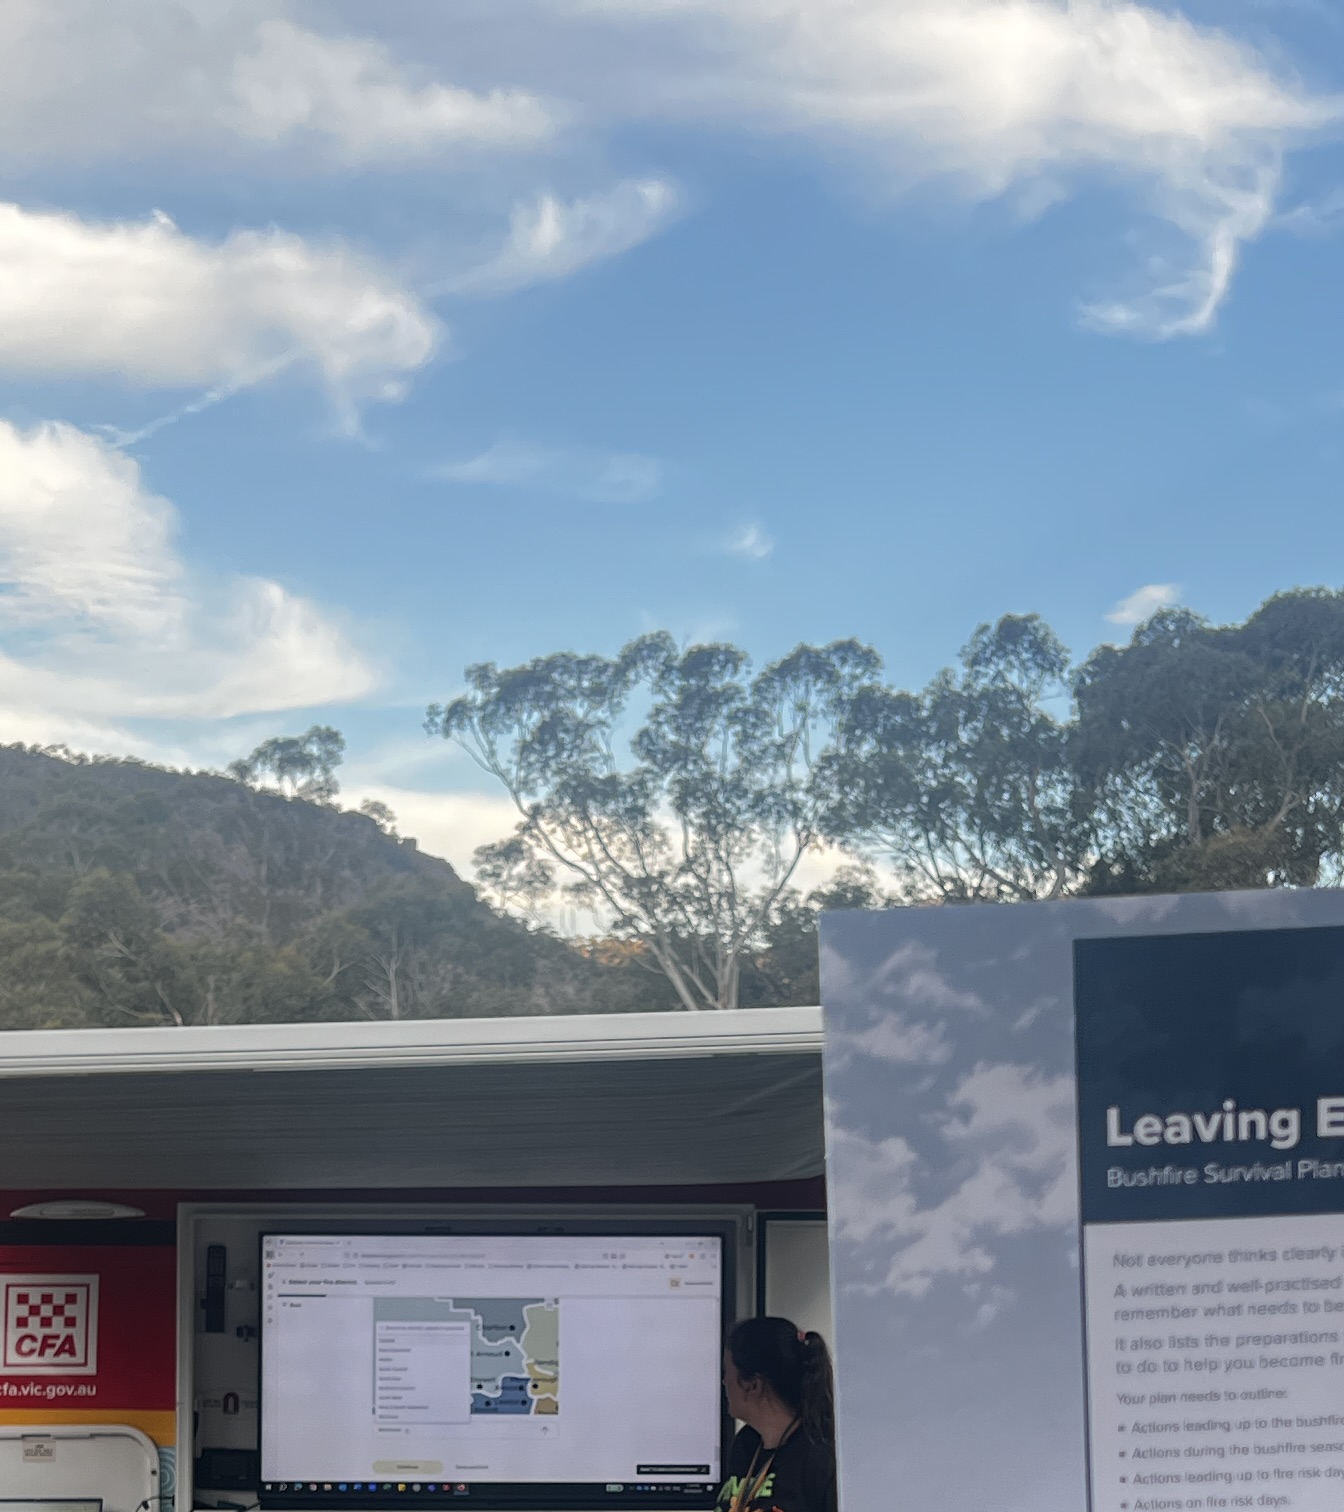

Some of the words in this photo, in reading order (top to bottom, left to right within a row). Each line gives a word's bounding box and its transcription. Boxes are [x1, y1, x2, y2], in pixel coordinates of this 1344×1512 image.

[1106, 1098, 1301, 1149] Leaving
[1106, 1164, 1198, 1188] Bushfire
[1203, 1160, 1292, 1184] Survival
[1112, 1252, 1142, 1268] Not
[1147, 1251, 1223, 1269] everyone
[1227, 1247, 1276, 1262] thinks
[1281, 1245, 1336, 1264] clearly
[1113, 1284, 1125, 1298] A
[1132, 1282, 1185, 1297] written
[1191, 1280, 1223, 1294] and
[1227, 1275, 1342, 1295] well-practised
[1114, 1305, 1198, 1321] remember
[1203, 1302, 1242, 1317] what
[1247, 1300, 1297, 1315] needs
[1302, 1300, 1319, 1313] to
[1324, 1298, 1344, 1312] be
[15, 1333, 77, 1358] CFA
[1114, 1338, 1124, 1350] It
[1129, 1336, 1162, 1350] also
[1168, 1334, 1198, 1348] lists
[1204, 1333, 1229, 1346] the
[1235, 1329, 1338, 1348] preparations
[1116, 1361, 1132, 1374] to
[1136, 1360, 1157, 1373] do
[1162, 1359, 1178, 1372] to
[1183, 1357, 1218, 1374] help
[1224, 1358, 1254, 1372] you
[1259, 1352, 1324, 1368] become
[1116, 1393, 1144, 1405] Your
[1149, 1392, 1176, 1405] plan
[1180, 1390, 1220, 1402] needs
[1224, 1390, 1236, 1400] to
[1131, 1420, 1179, 1433] Actions
[1183, 1418, 1230, 1433] leading
[1235, 1420, 1250, 1431] up
[1255, 1418, 1267, 1428] to
[1271, 1417, 1292, 1428] the
[1132, 1446, 1179, 1459] Actions
[1183, 1445, 1224, 1459] during
[1229, 1443, 1249, 1455] the
[1253, 1441, 1305, 1454] bushfire
[1133, 1472, 1180, 1484] Actions
[1185, 1470, 1231, 1485] leading
[1236, 1471, 1252, 1482] up
[1257, 1469, 1269, 1479] to
[1273, 1467, 1293, 1479] fire
[1298, 1467, 1320, 1478] risk
[1134, 1497, 1181, 1510] Actions
[1185, 1500, 1201, 1508] on
[1206, 1495, 1226, 1507] fire
[1230, 1495, 1252, 1507] risk
